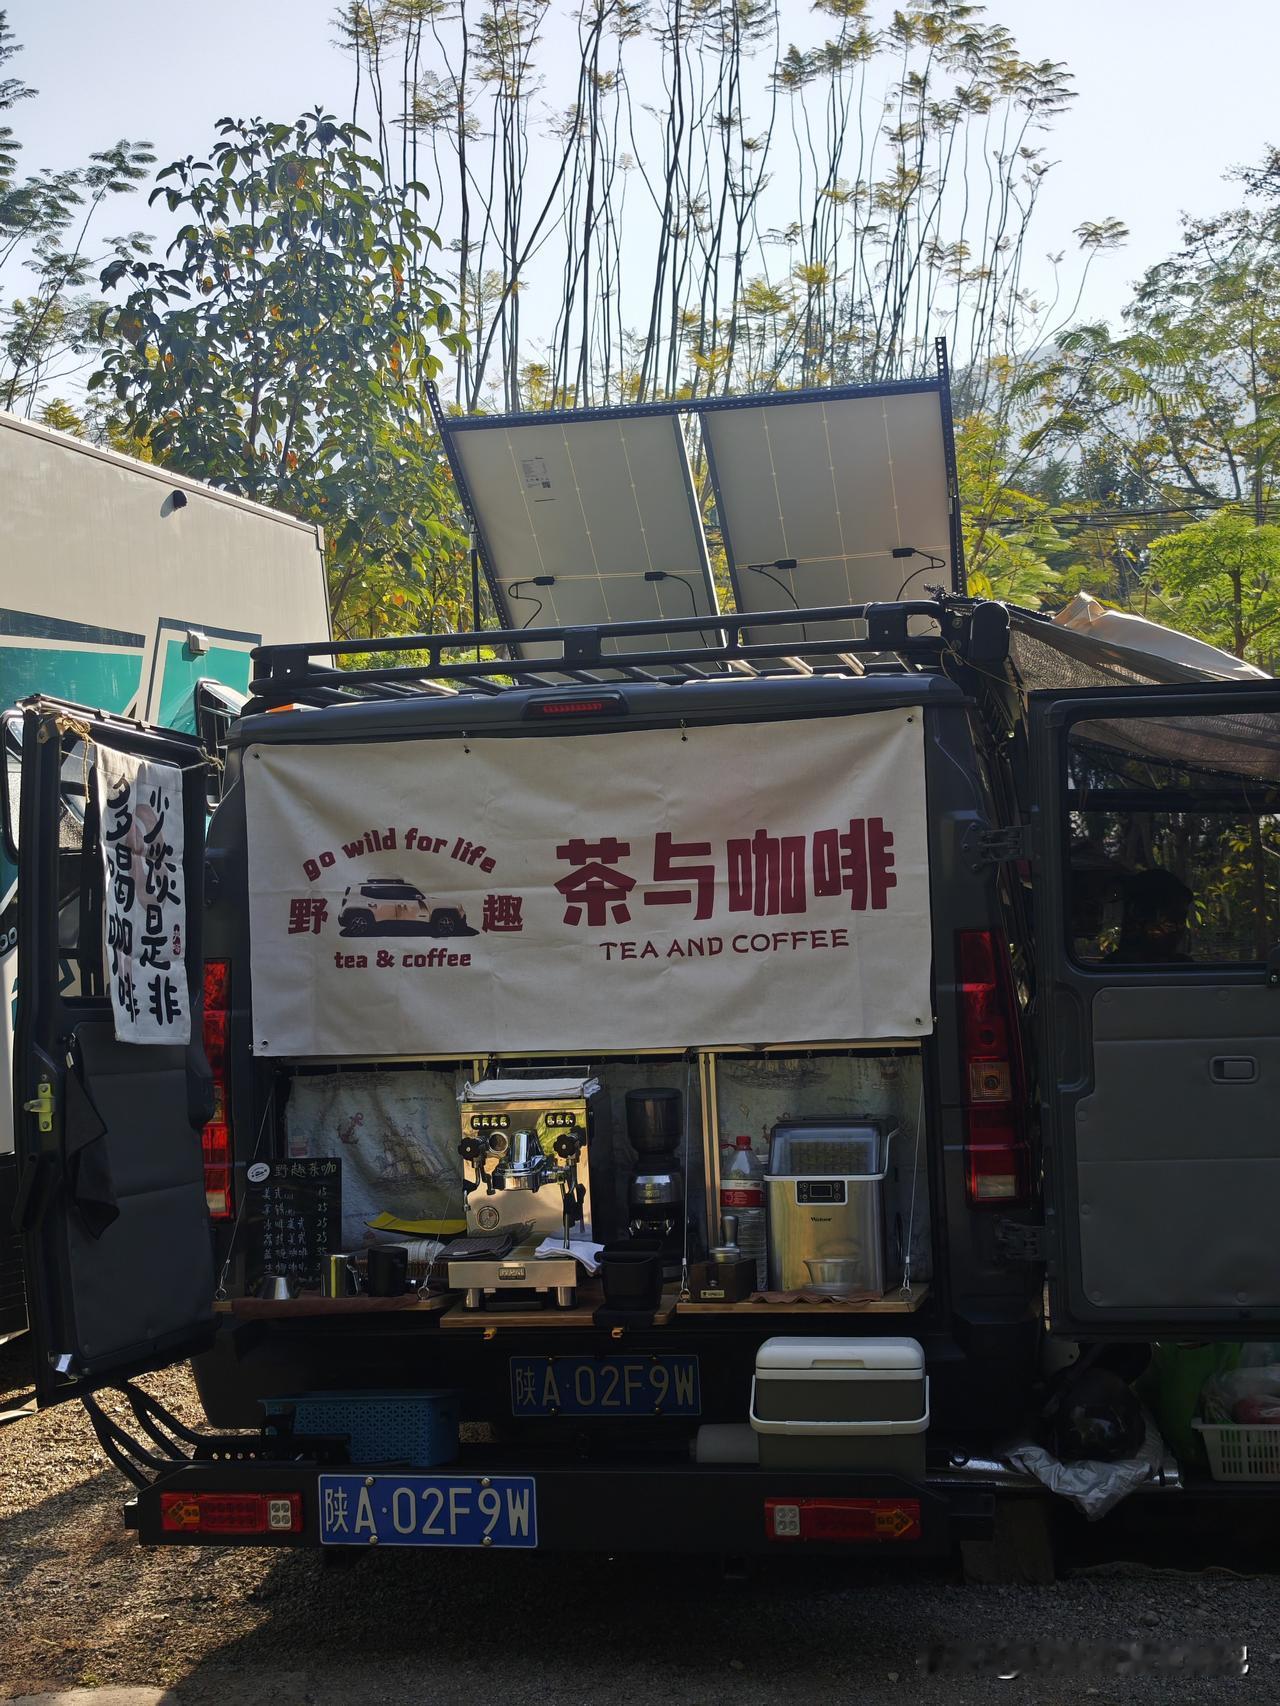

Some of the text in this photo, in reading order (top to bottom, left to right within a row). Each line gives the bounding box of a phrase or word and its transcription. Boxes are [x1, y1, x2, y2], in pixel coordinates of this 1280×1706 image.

[303, 827, 497, 881] go wild for life
[554, 817, 897, 926] 茶与咖啡
[106, 773, 141, 1024] 多喝咖啡
[287, 894, 524, 935] 野 趣
[334, 948, 472, 969] tea & coffee
[600, 928, 849, 961] TEA AND COFFEE
